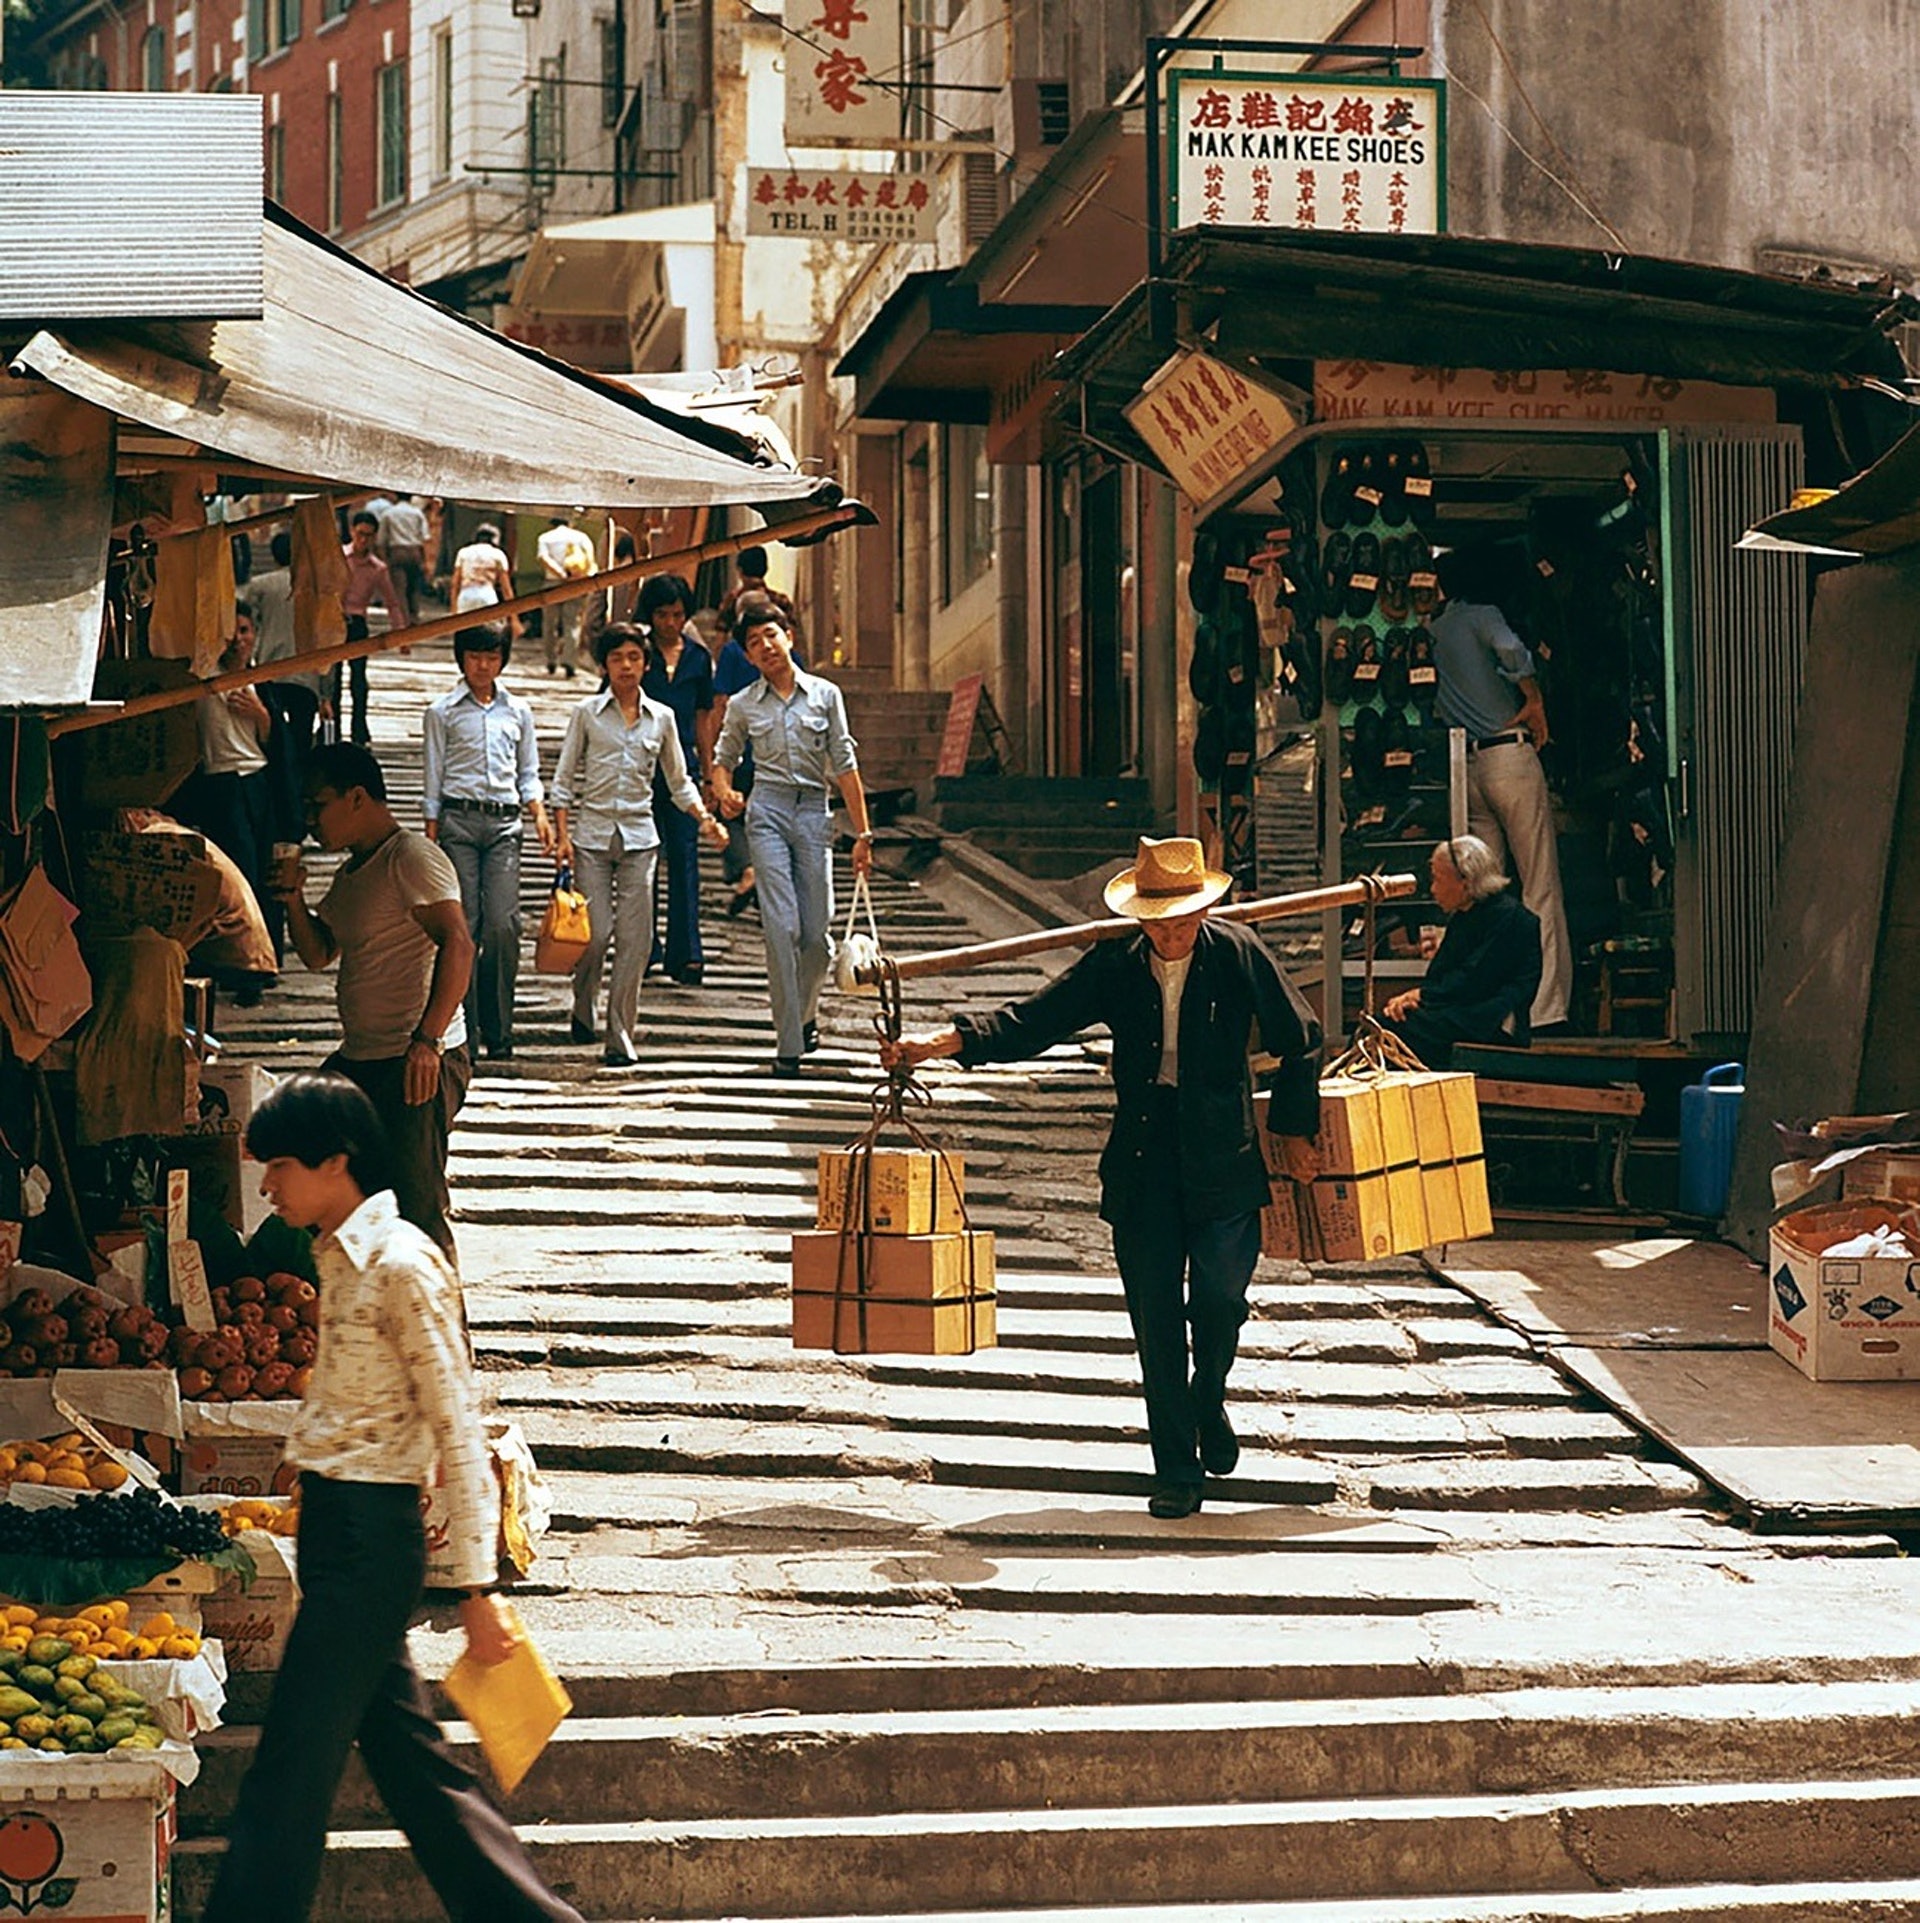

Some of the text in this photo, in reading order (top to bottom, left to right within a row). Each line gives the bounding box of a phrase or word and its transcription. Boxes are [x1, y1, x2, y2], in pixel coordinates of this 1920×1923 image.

[1188, 131, 1425, 165] MAK KAM KEE SHOES
[1341, 168, 1363, 231] 時款皮
